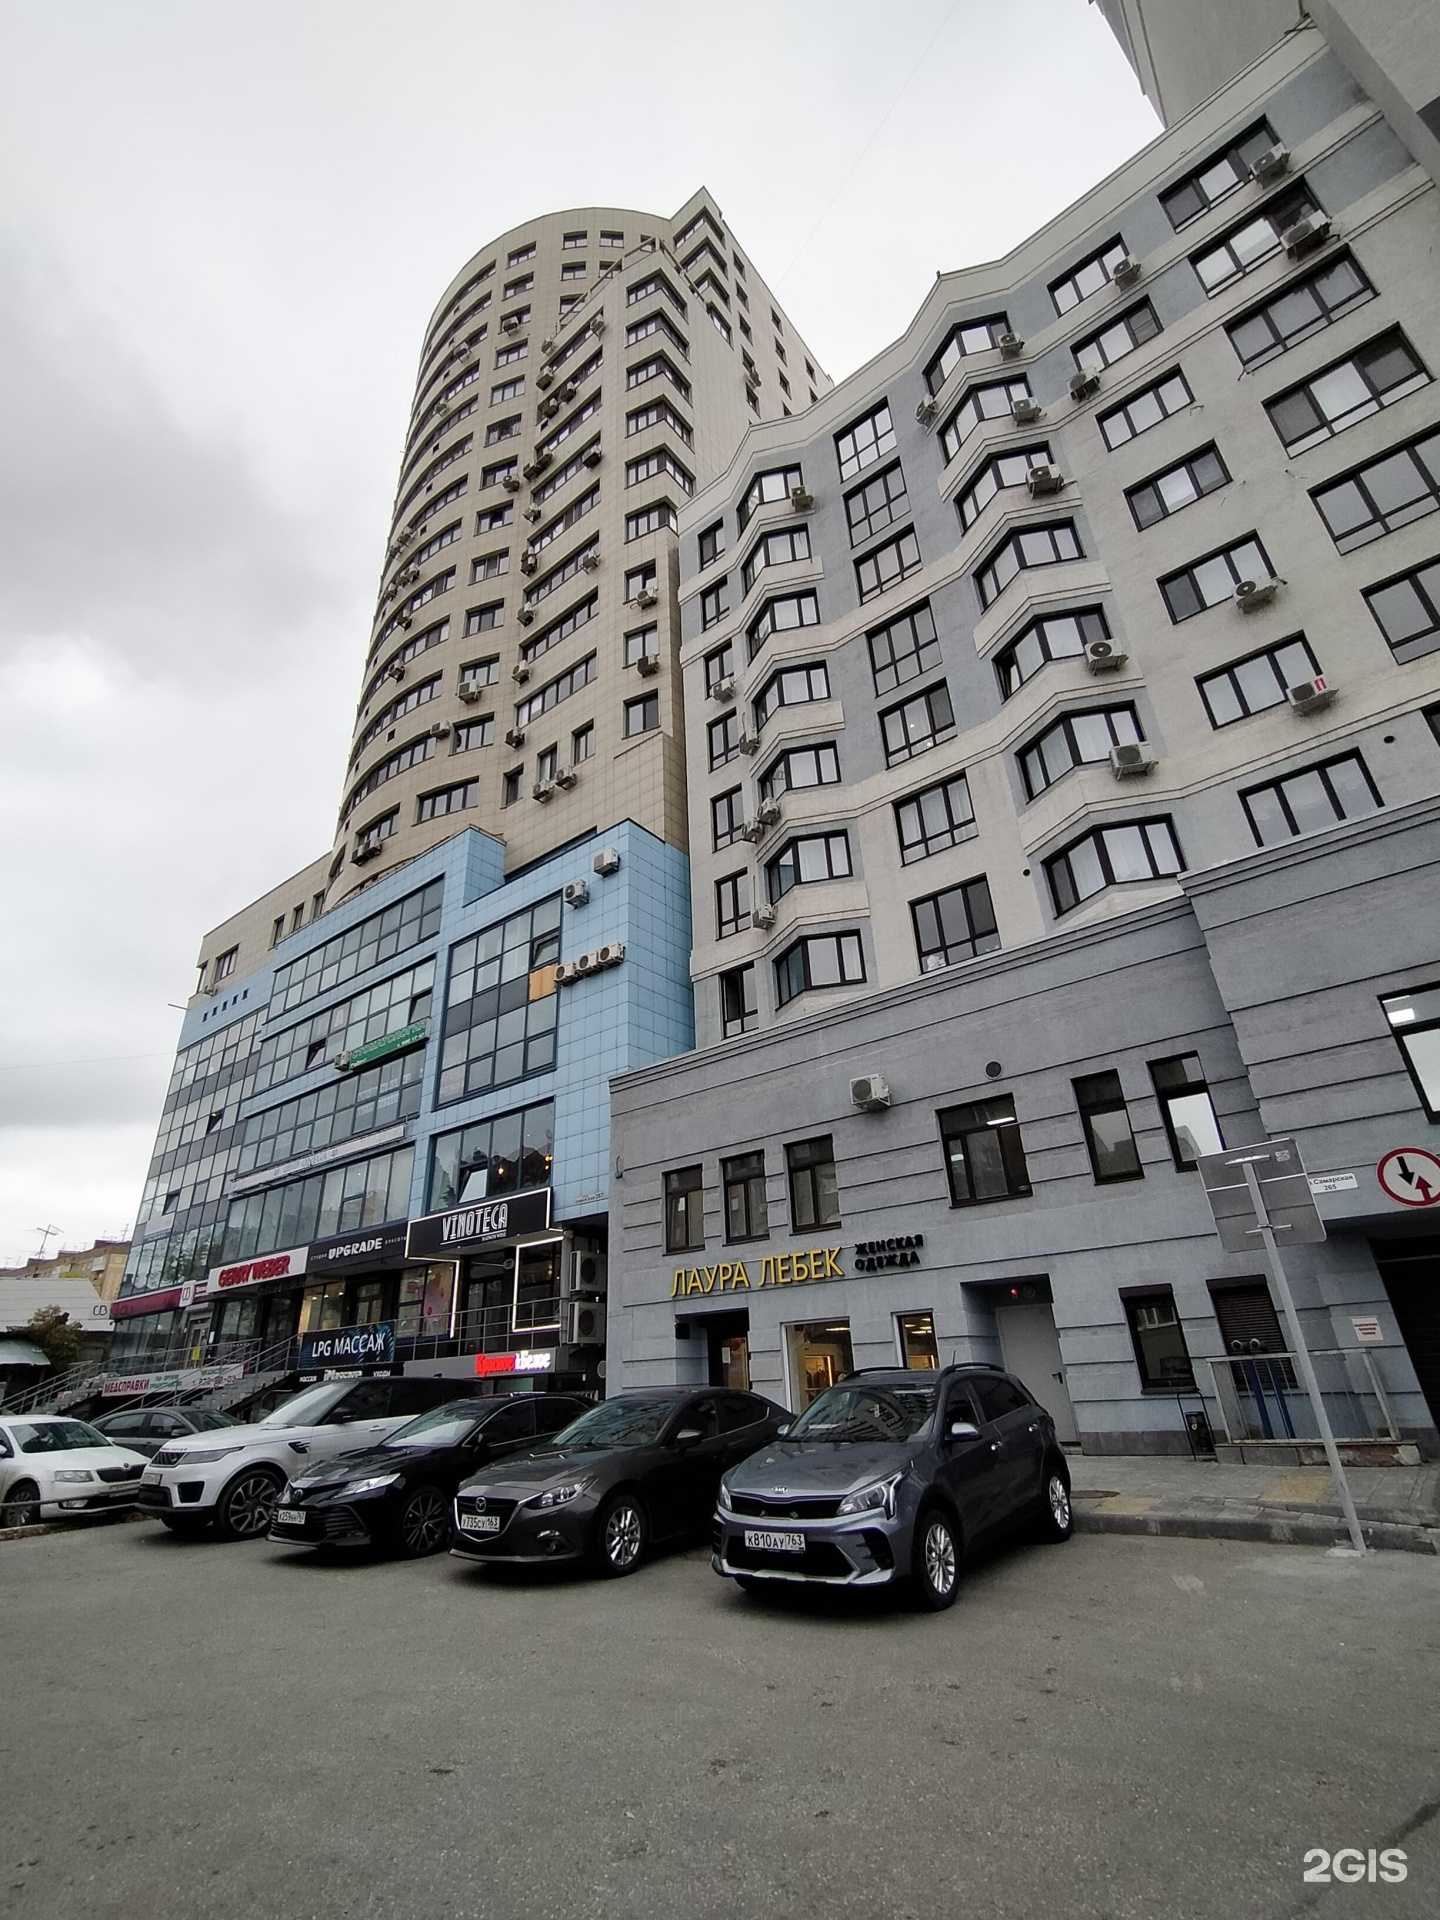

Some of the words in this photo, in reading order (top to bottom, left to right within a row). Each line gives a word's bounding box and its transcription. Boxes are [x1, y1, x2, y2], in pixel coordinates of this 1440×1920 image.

[442, 1203, 508, 1241] VINOTECA
[328, 1238, 383, 1259] UPGRADE
[854, 1234, 924, 1256] ЖЕНСКАЯ
[671, 1261, 750, 1297] ЛАУРА
[758, 1247, 845, 1287] ЛЕБЕК
[854, 1251, 921, 1272] ОДЕЖДА
[311, 1340, 332, 1358] LPG
[333, 1332, 386, 1356] МАССАЖ
